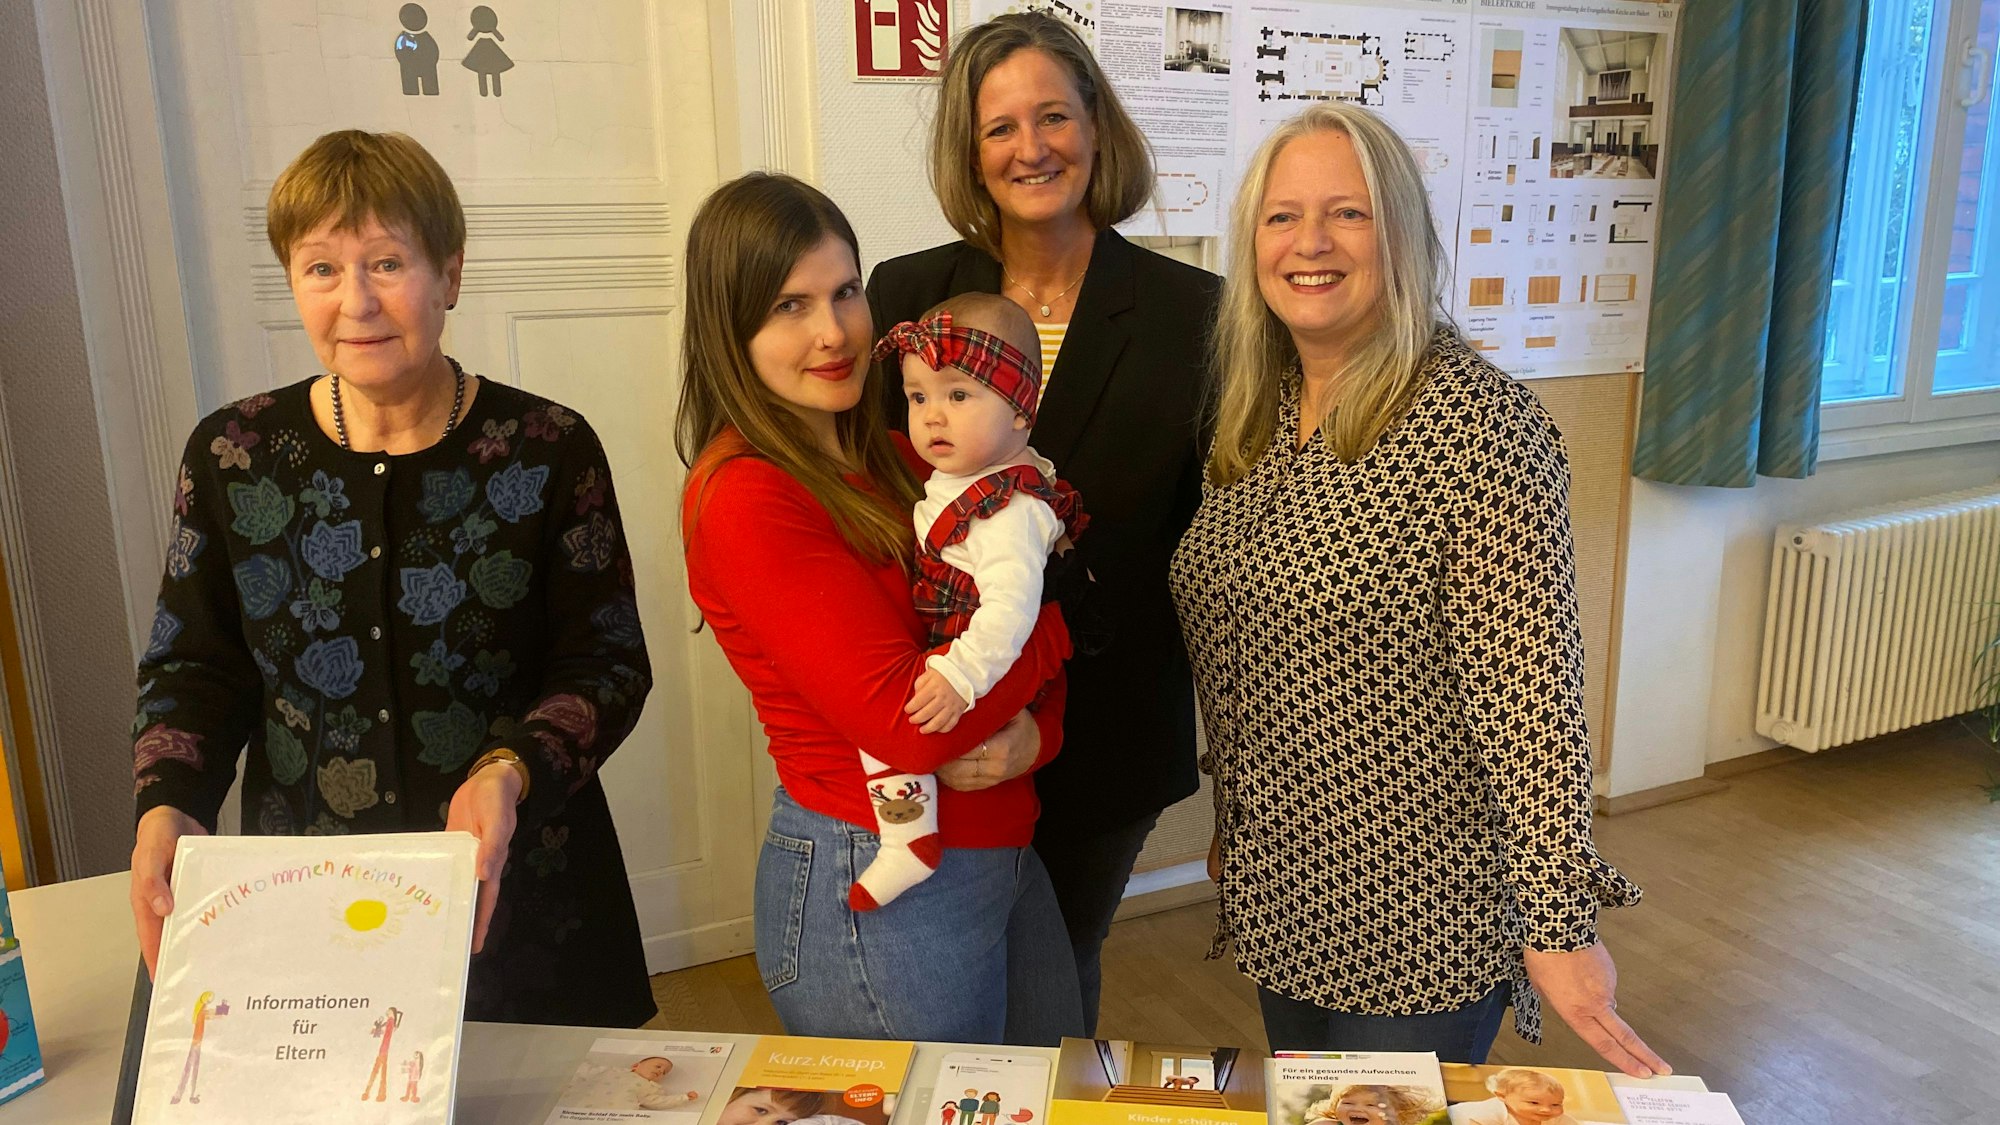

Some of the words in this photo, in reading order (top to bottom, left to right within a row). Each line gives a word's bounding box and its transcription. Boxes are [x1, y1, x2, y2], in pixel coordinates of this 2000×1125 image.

[1480, 0, 1536, 9] BIELERTKIRCHE
[246, 994, 370, 1010] Informationen
[292, 1019, 317, 1035] für
[275, 1045, 326, 1060] Eltern
[1128, 1114, 1172, 1124] Kinder
